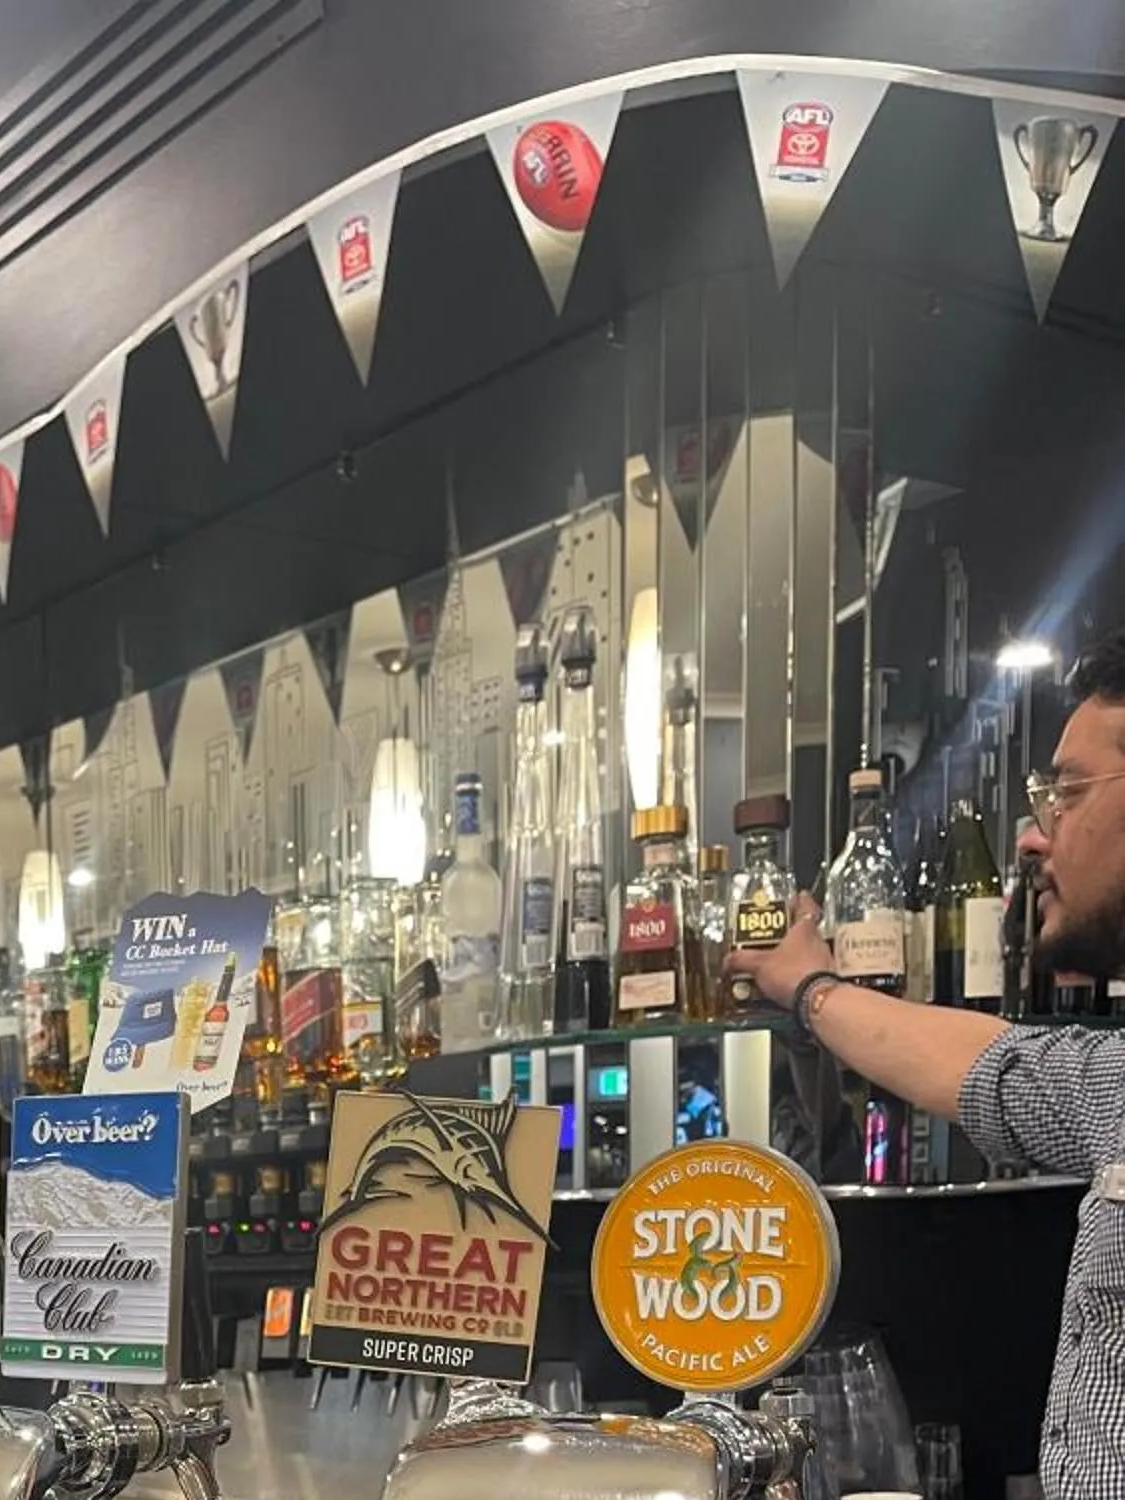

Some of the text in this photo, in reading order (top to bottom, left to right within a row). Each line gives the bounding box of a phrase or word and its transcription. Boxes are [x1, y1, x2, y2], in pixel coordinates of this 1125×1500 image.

[131, 913, 188, 942] WIN
[629, 919, 666, 938] 1800
[739, 910, 785, 931] 1800
[32, 1114, 158, 1144] Over beer?
[647, 1161, 775, 1195] THE ORIGINAL
[634, 1207, 786, 1258] STONE
[11, 1230, 159, 1280] Canadian
[331, 1226, 533, 1284] GREAT
[36, 1281, 116, 1332] Club
[327, 1272, 526, 1318] NORTHERN
[633, 1273, 782, 1321] WOOD
[358, 1307, 456, 1331] BREWING
[41, 1344, 120, 1361] DRY
[363, 1338, 474, 1367] SUPER CRISP
[640, 1334, 771, 1371] PACIFIC ALE
